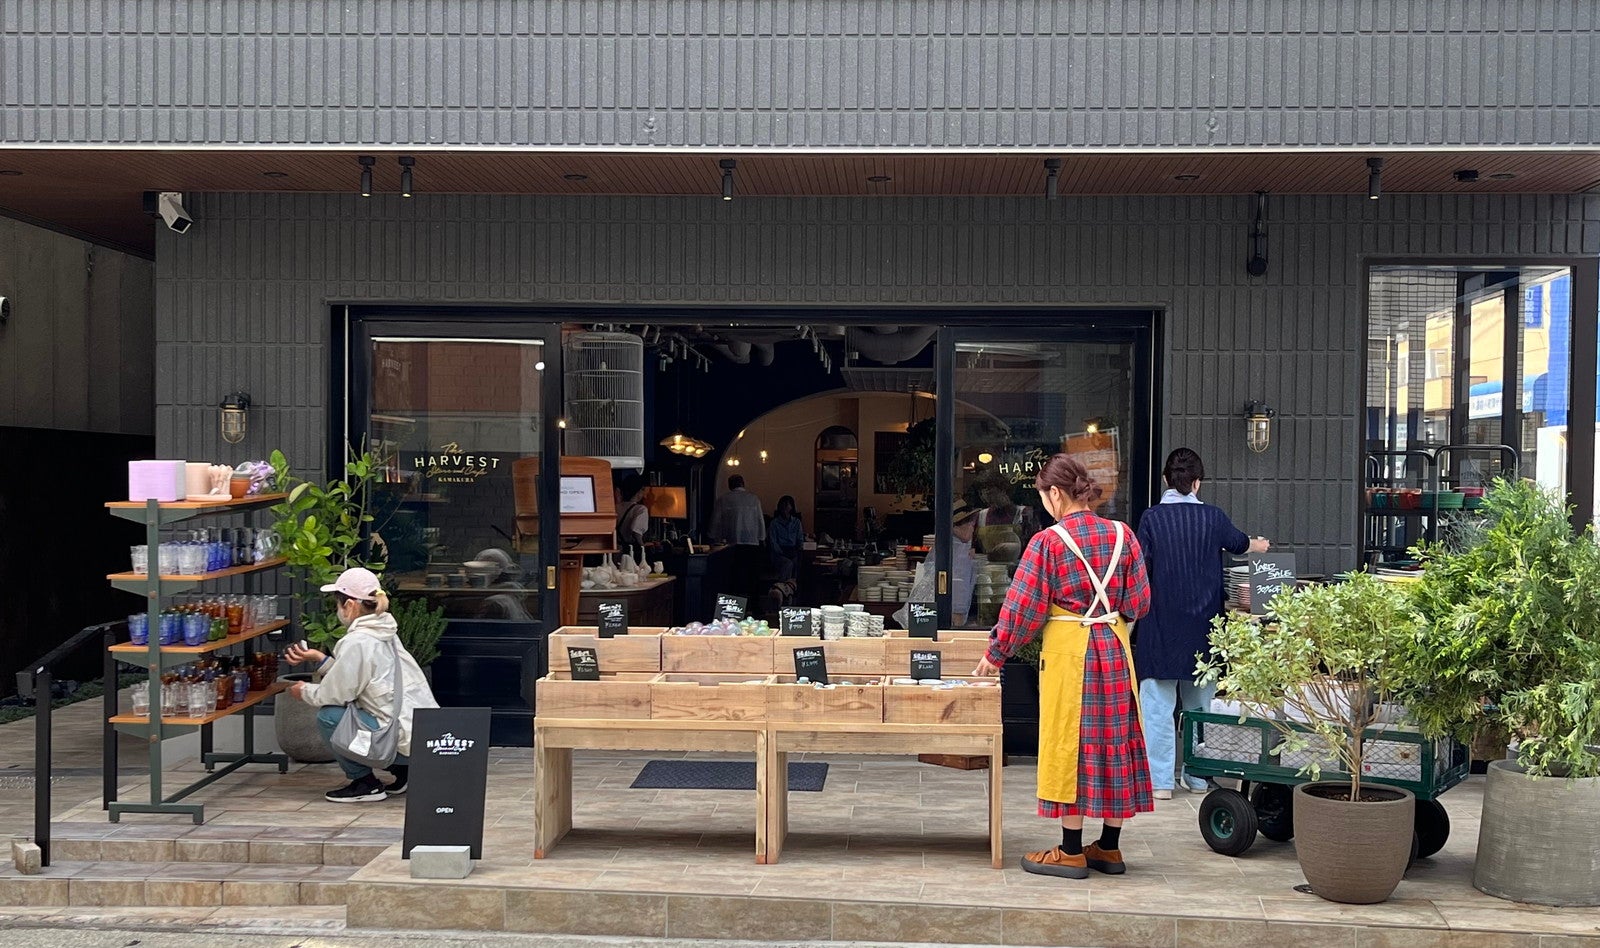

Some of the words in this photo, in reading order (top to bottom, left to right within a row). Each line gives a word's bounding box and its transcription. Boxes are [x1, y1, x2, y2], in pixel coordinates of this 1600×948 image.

[441, 442, 465, 455] The
[414, 455, 500, 468] HARVEST
[999, 461, 1047, 474] HARV
[1252, 559, 1276, 573] YARD
[1267, 569, 1292, 578] SALE
[1256, 584, 1281, 594] 30%OF
[426, 740, 475, 748] HARVEST
